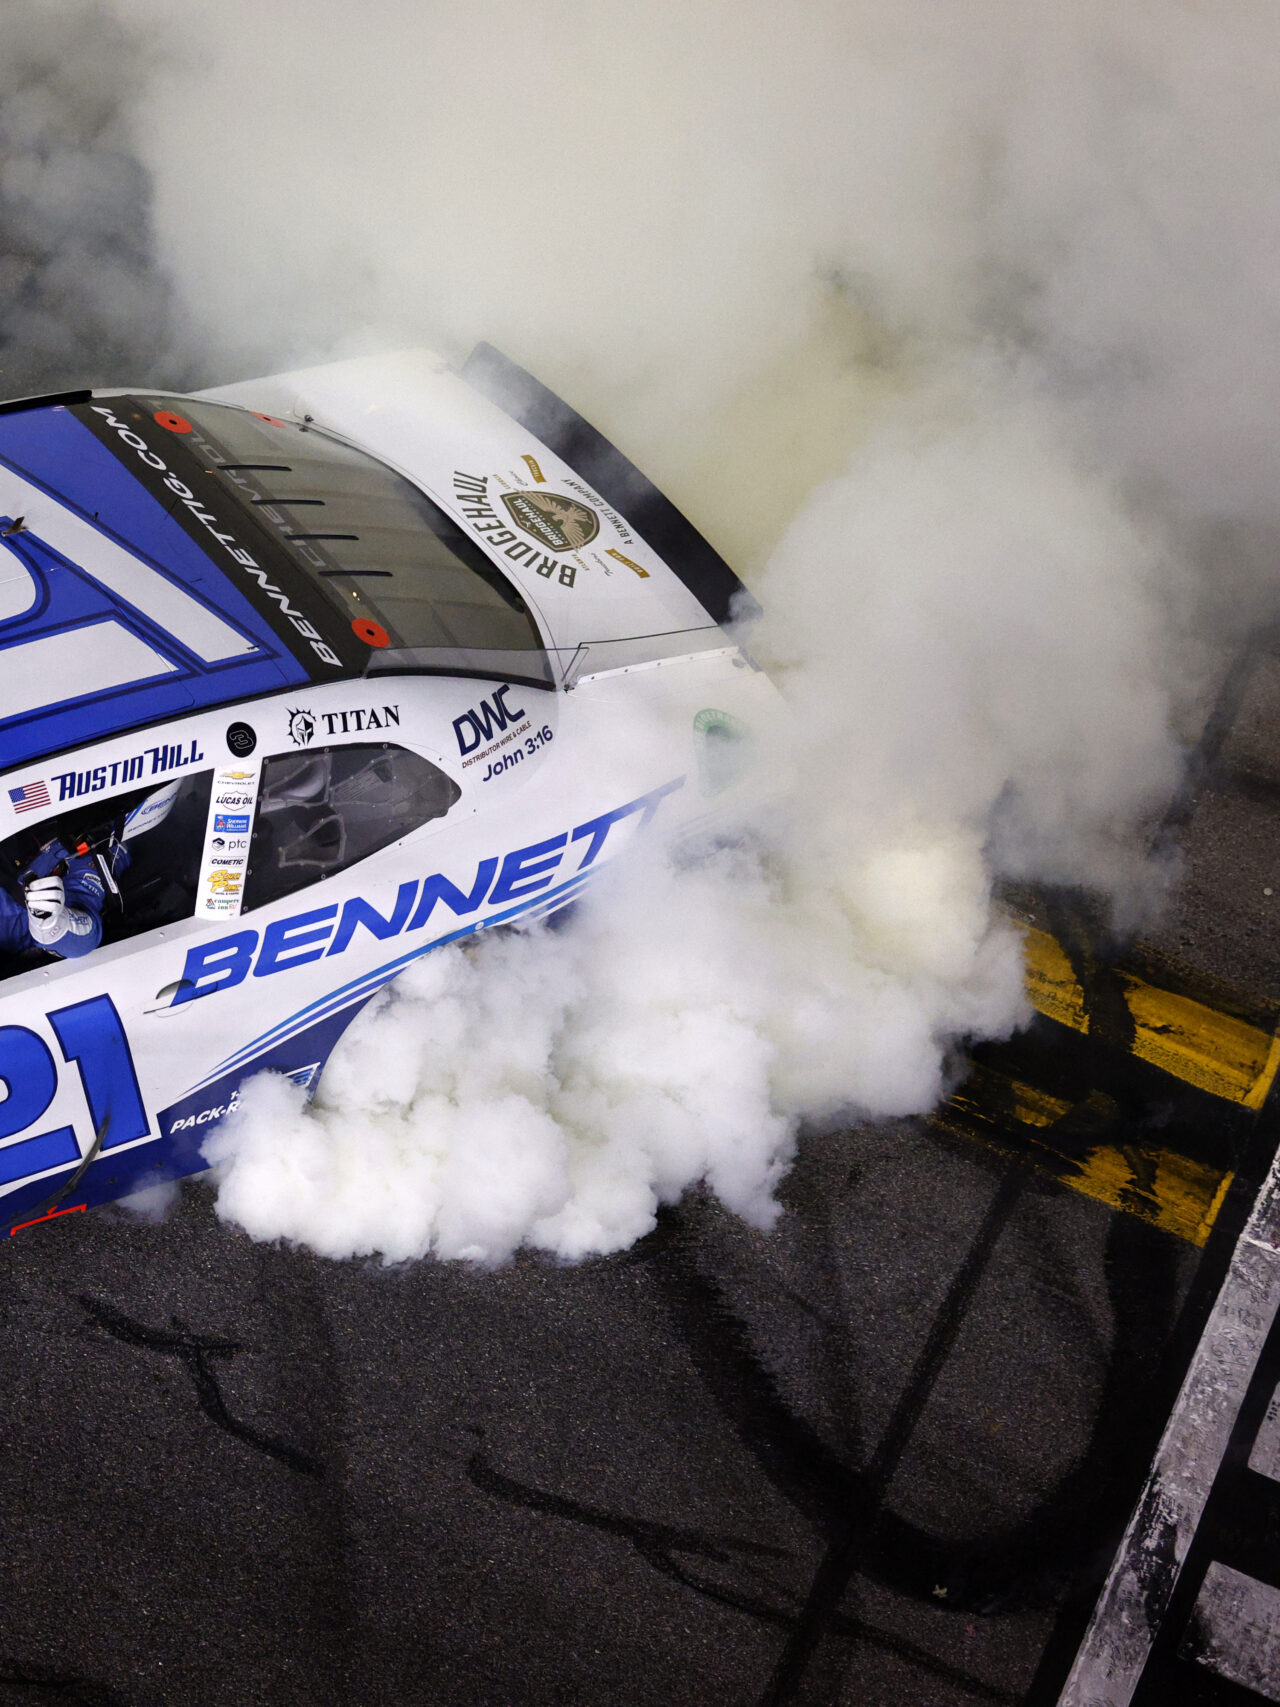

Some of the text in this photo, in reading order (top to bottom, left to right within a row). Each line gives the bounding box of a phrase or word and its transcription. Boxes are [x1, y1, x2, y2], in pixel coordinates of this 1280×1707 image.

[147, 396, 327, 569] CHEVROLT
[560, 478, 604, 506] COMPANY
[90, 405, 343, 668] BENNETTIG.COM
[453, 470, 577, 589] BRIDGEHAUL
[512, 497, 564, 546] BRIDGEHAUL
[600, 507, 630, 537] BENNETT
[322, 704, 401, 734] TITAN
[451, 683, 525, 756] DWC
[461, 741, 500, 769] DISTRIBUTOR
[499, 732, 514, 746] WIRE
[515, 719, 532, 735] CABLE
[483, 724, 555, 783] John 3:16
[51, 740, 204, 801] AUSTIN HILL
[216, 796, 253, 805] LUCAS OIL
[228, 838, 247, 851] ptc
[169, 1098, 240, 1133] PACK-R
